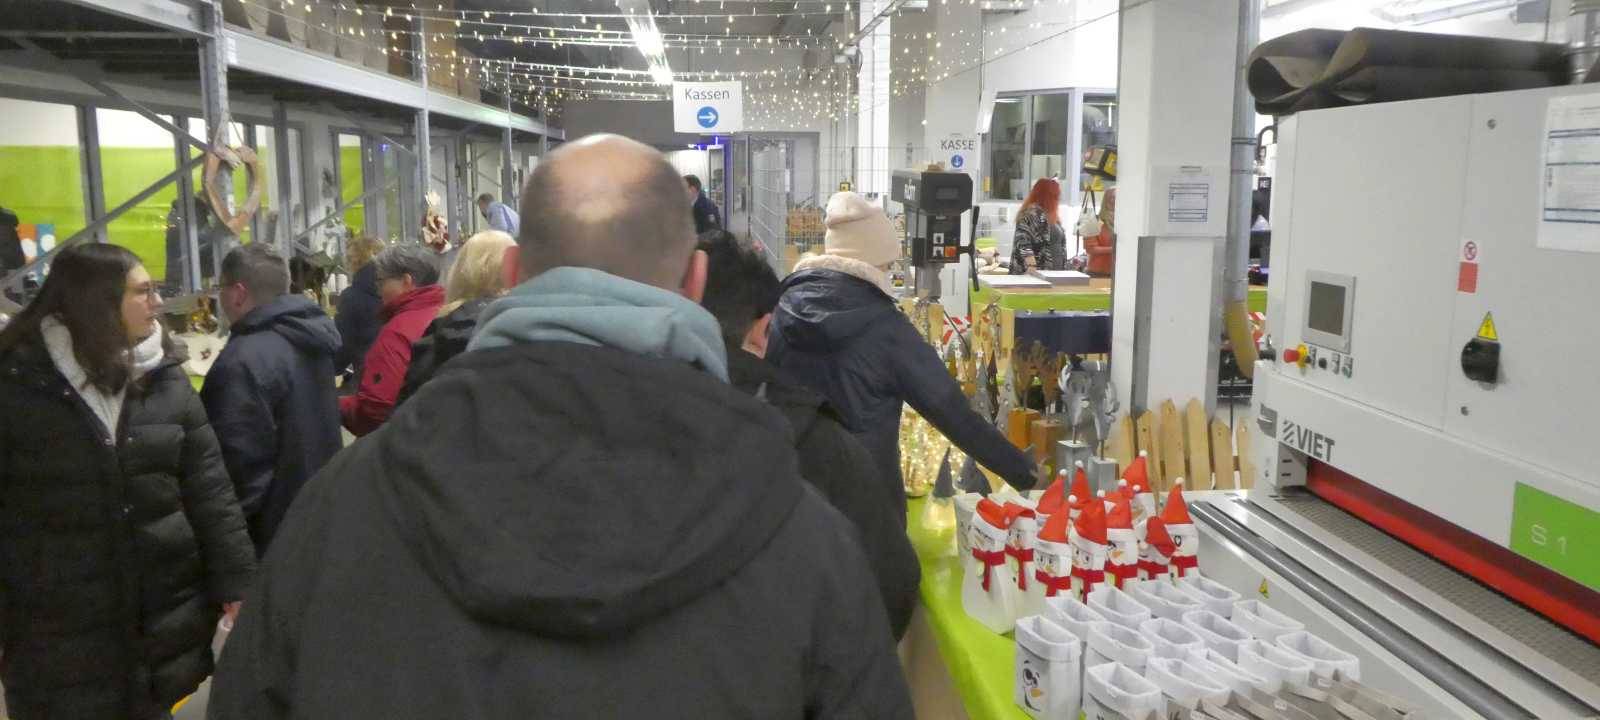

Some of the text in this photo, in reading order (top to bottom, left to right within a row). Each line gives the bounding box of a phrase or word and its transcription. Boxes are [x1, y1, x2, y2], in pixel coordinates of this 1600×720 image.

[685, 88, 730, 100] Kassen
[940, 139, 975, 151] KASSE
[1297, 424, 1336, 462] VIET
[1531, 523, 1568, 555] S 1
